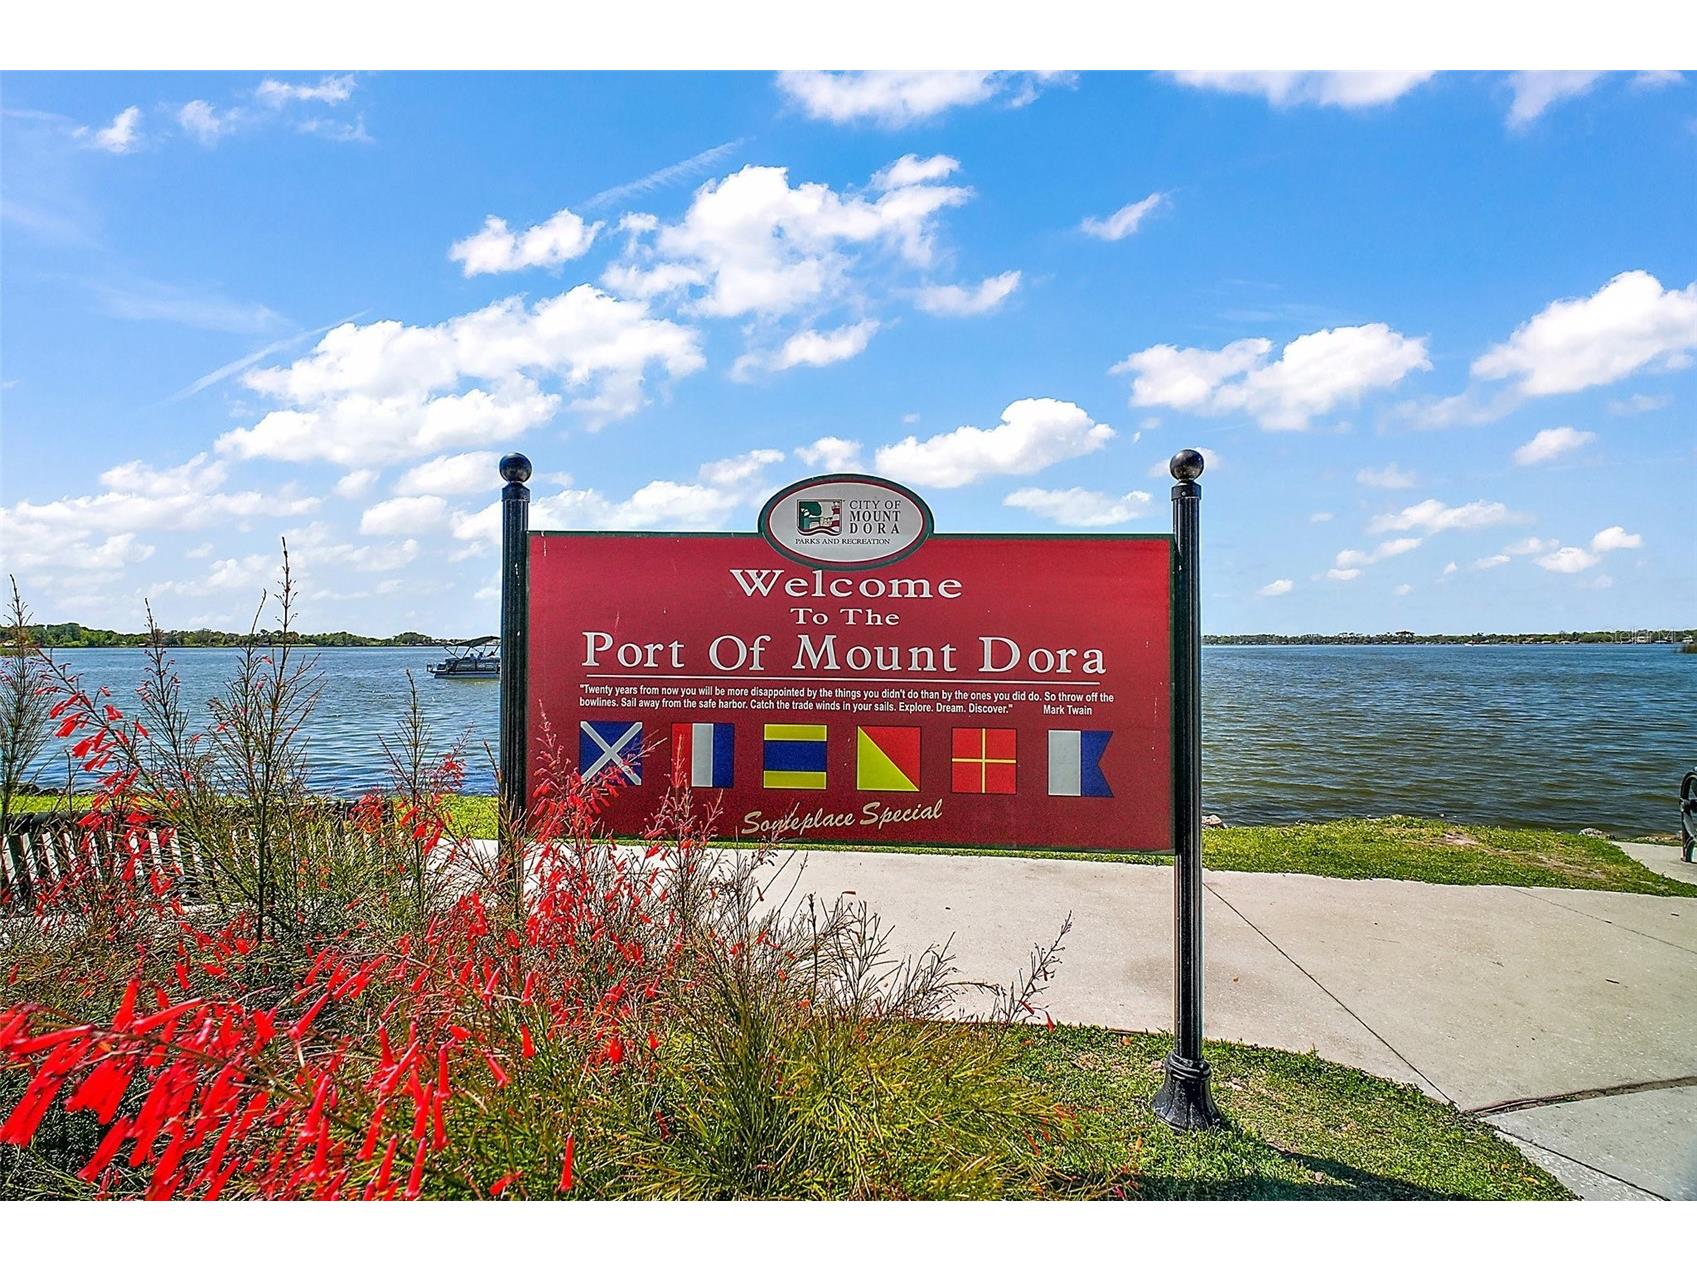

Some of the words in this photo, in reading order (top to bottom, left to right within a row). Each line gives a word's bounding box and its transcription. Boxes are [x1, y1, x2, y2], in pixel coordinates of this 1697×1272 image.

[850, 500, 880, 510] CITY
[885, 500, 901, 510] OF
[850, 510, 901, 522] MOUNT
[850, 523, 900, 534] DORA
[730, 569, 962, 598] Welcome
[790, 608, 829, 625] To
[840, 608, 900, 626] The
[582, 631, 685, 668] Port
[709, 635, 771, 671] Of
[792, 634, 957, 672] Mount
[978, 636, 1106, 674] Dora
[615, 687, 638, 696] years
[640, 685, 659, 695] from
[661, 687, 679, 695] now
[681, 687, 696, 697] you
[699, 686, 713, 696] will
[715, 686, 725, 696] be
[727, 688, 749, 696] more
[750, 687, 805, 699] disappointed
[807, 688, 818, 699] by
[819, 688, 833, 697] the
[835, 688, 861, 700] things
[863, 690, 879, 700] you
[881, 689, 906, 699] didn't
[907, 689, 919, 699] do
[921, 689, 939, 699] than
[942, 690, 952, 701] by
[954, 690, 968, 700] the
[970, 692, 991, 700] ones
[993, 692, 1010, 702] you
[1012, 691, 1026, 701] did
[1028, 691, 1042, 701] do.
[1044, 692, 1056, 701] So
[1058, 692, 1083, 702] throw
[1085, 692, 1098, 702] off
[1100, 692, 1114, 702] the
[580, 697, 619, 707] bowlines.
[621, 697, 637, 707] Sail
[639, 699, 660, 709] away
[662, 698, 681, 708] from
[683, 698, 697, 708] the
[699, 699, 716, 709] safe
[718, 699, 748, 709] harbor.
[750, 699, 774, 709] Catch
[777, 700, 790, 710] the
[792, 700, 813, 710] trade
[816, 700, 840, 710] winds
[843, 701, 851, 711] in
[853, 702, 872, 713] your
[874, 701, 897, 712] sails.
[899, 702, 934, 714] Explore.
[936, 702, 966, 713] Dream.
[969, 703, 1013, 714] Discover."
[1043, 704, 1065, 715] Mark
[1067, 704, 1093, 715] Twain
[860, 799, 943, 829] Special
